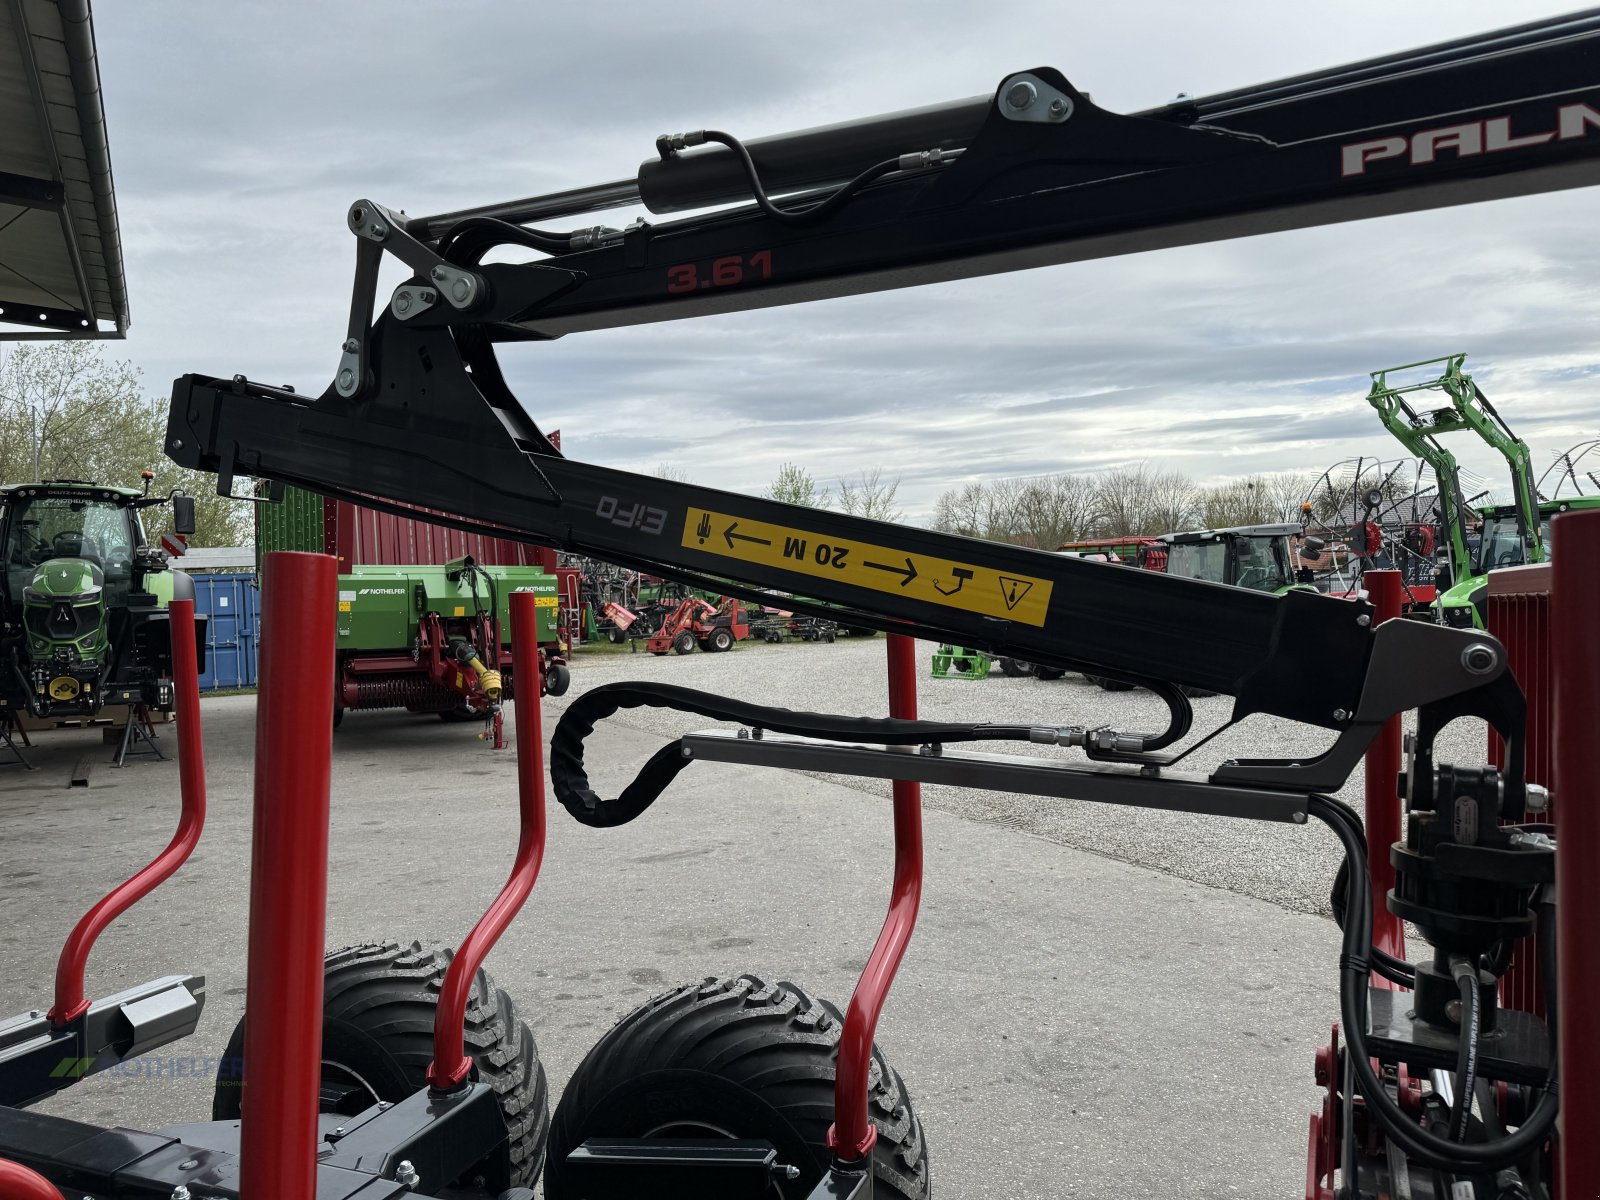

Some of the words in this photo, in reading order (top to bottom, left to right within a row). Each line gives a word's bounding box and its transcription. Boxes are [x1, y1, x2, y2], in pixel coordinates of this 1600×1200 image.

[667, 249, 772, 293] 3.61
[782, 535, 809, 562] M
[814, 541, 850, 571] 20
